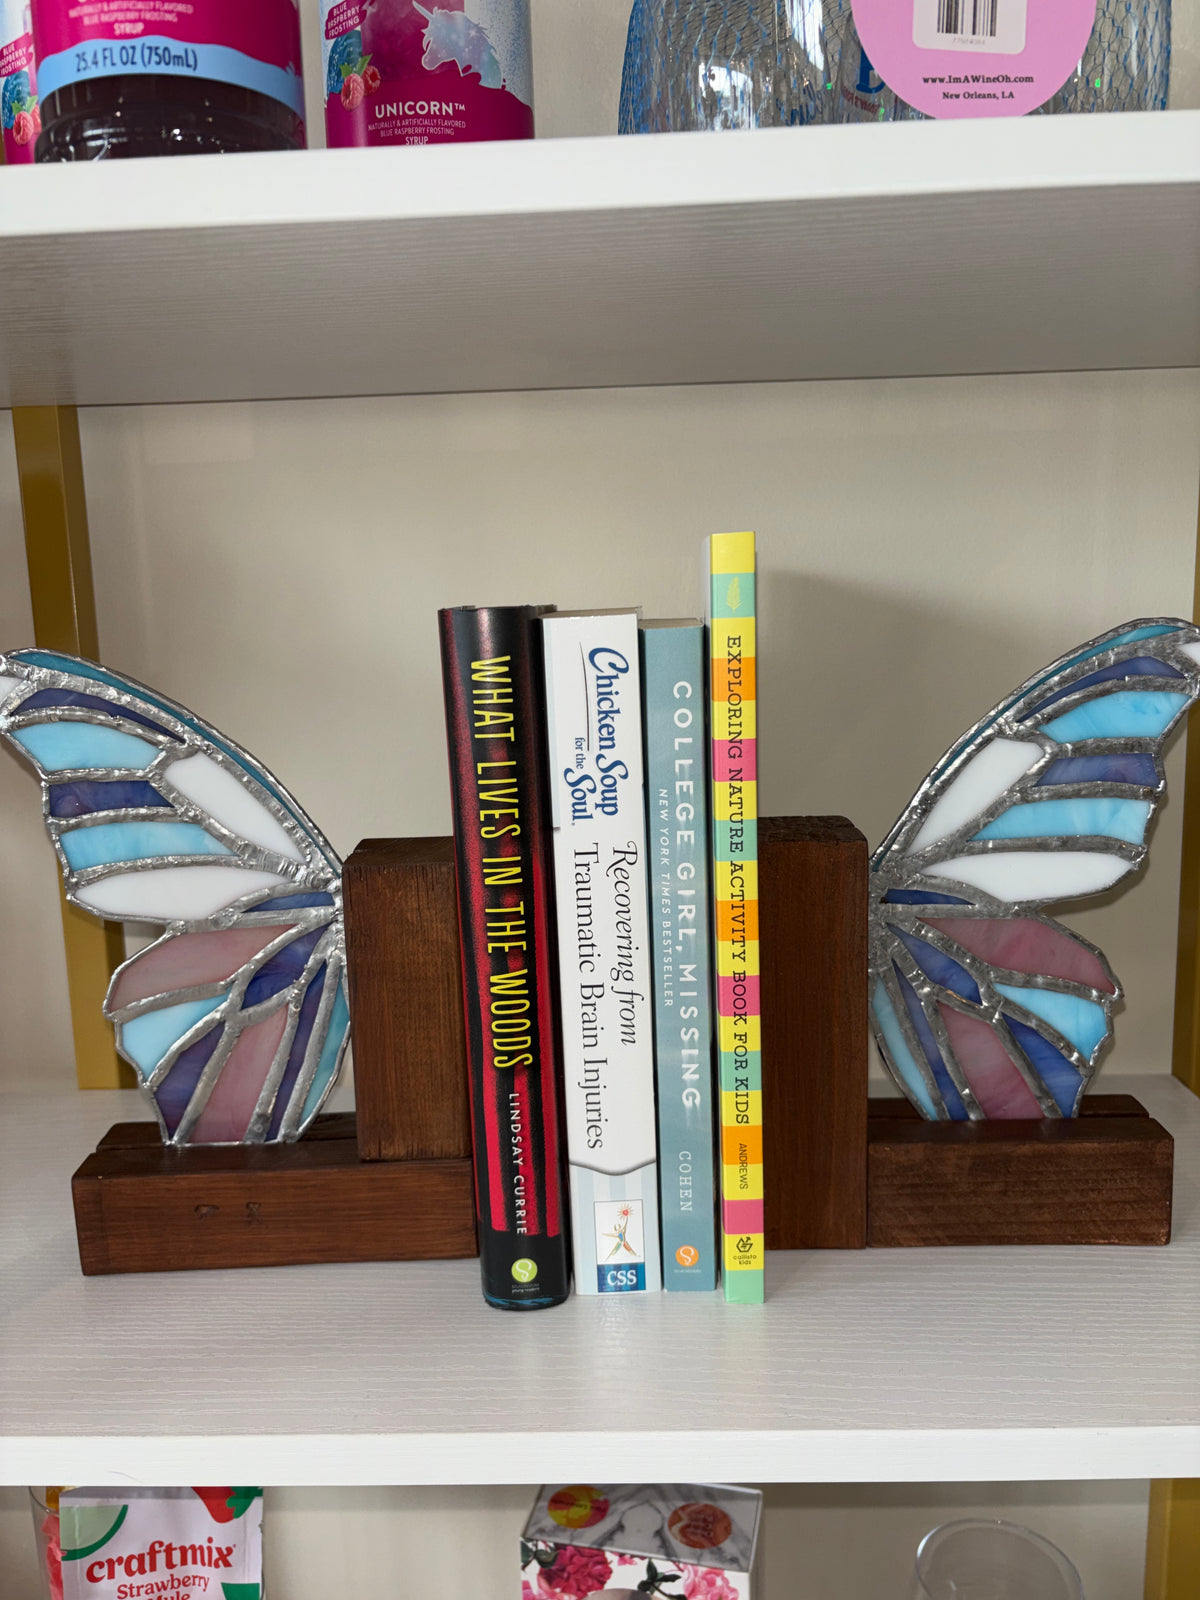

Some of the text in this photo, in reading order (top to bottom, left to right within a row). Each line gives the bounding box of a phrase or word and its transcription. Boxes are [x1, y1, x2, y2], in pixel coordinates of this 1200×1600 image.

[327, 5, 360, 30] RASPBERRY
[333, 2, 347, 17] BLUE
[113, 22, 144, 36] SYRUP
[328, 15, 360, 39] FROSTING
[76, 42, 198, 73] 25.4 FL OZ (750mL)
[922, 74, 1035, 84] www.ImAWineOh.com
[942, 91, 1015, 101] New Orleans, LA
[367, 120, 396, 131] NATURALLY
[401, 118, 437, 127] ARTIFICIALLY
[438, 118, 466, 129] FLAVORED
[380, 126, 455, 138] BLUE RASPBERRY FROSTING
[405, 135, 429, 146] SYRUP
[588, 646, 630, 817] Chicken Soup
[574, 737, 586, 770] for the
[470, 655, 533, 1068] WHAT LIVES IN THE WOODS
[672, 680, 701, 1109] COLLEGE GIRL, MISSING
[726, 635, 750, 1125] EXPLORING NATURE ACTIVITY BOOK FOR KIDS
[658, 788, 673, 1007] NEW YORK TIMES BESTSELLER
[606, 840, 644, 1046] Recovering from
[573, 842, 608, 1149] Traumatic Brain Injuries
[508, 1092, 528, 1235] LINDSAY CURRIE
[738, 1143, 749, 1191] ANDREWS
[678, 1150, 693, 1212] COHEN
[607, 1269, 637, 1286] CSS
[86, 1536, 234, 1583] craftmix
[117, 1573, 210, 1600] Strawberry
